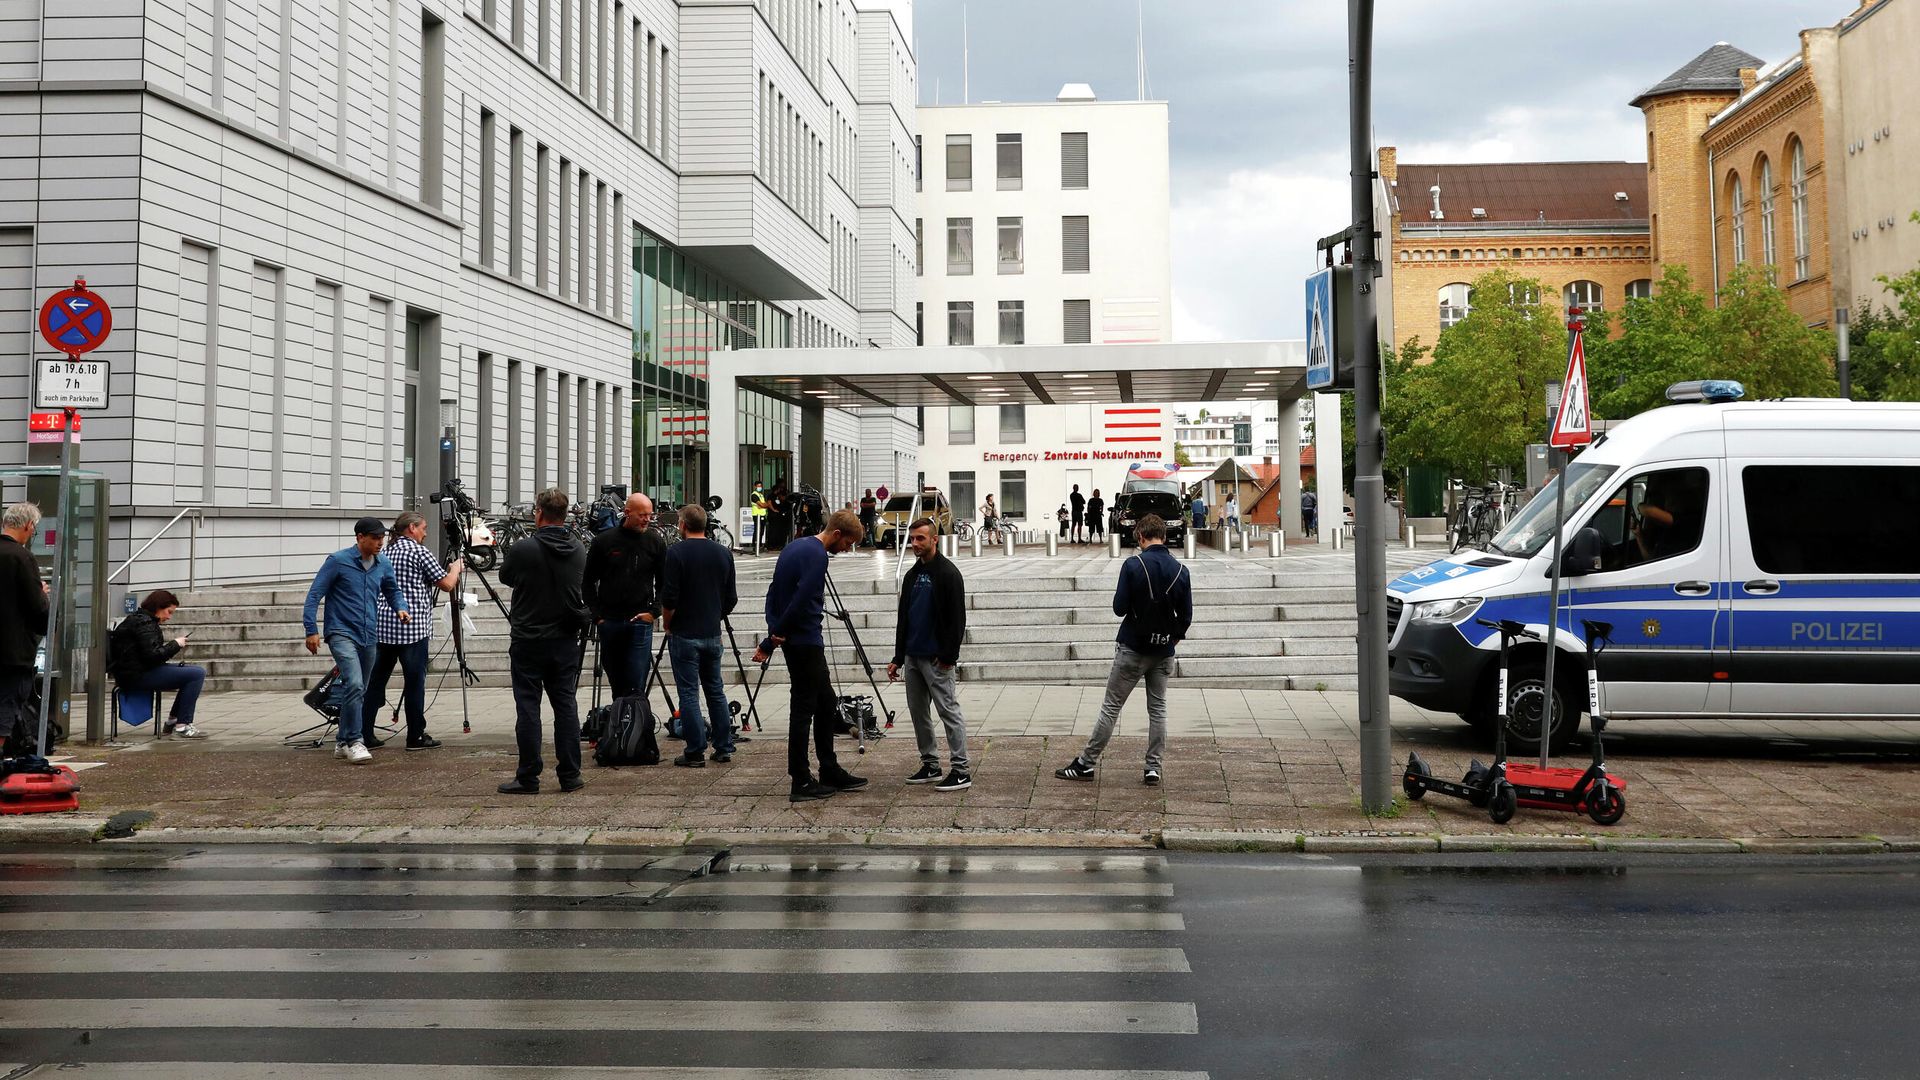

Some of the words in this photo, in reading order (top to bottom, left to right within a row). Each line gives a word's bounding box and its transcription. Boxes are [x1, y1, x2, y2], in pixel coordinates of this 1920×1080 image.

[49, 363, 61, 373] ab
[65, 363, 97, 374] 19.6.18
[65, 378, 71, 389] 7
[74, 379, 80, 389] h
[983, 452, 1039, 463] Emergency
[1044, 451, 1088, 461] Zentrale
[1092, 450, 1162, 460] Notaufnahme
[1791, 622, 1883, 641] POLIZEI
[1589, 678, 1597, 708] BIRD
